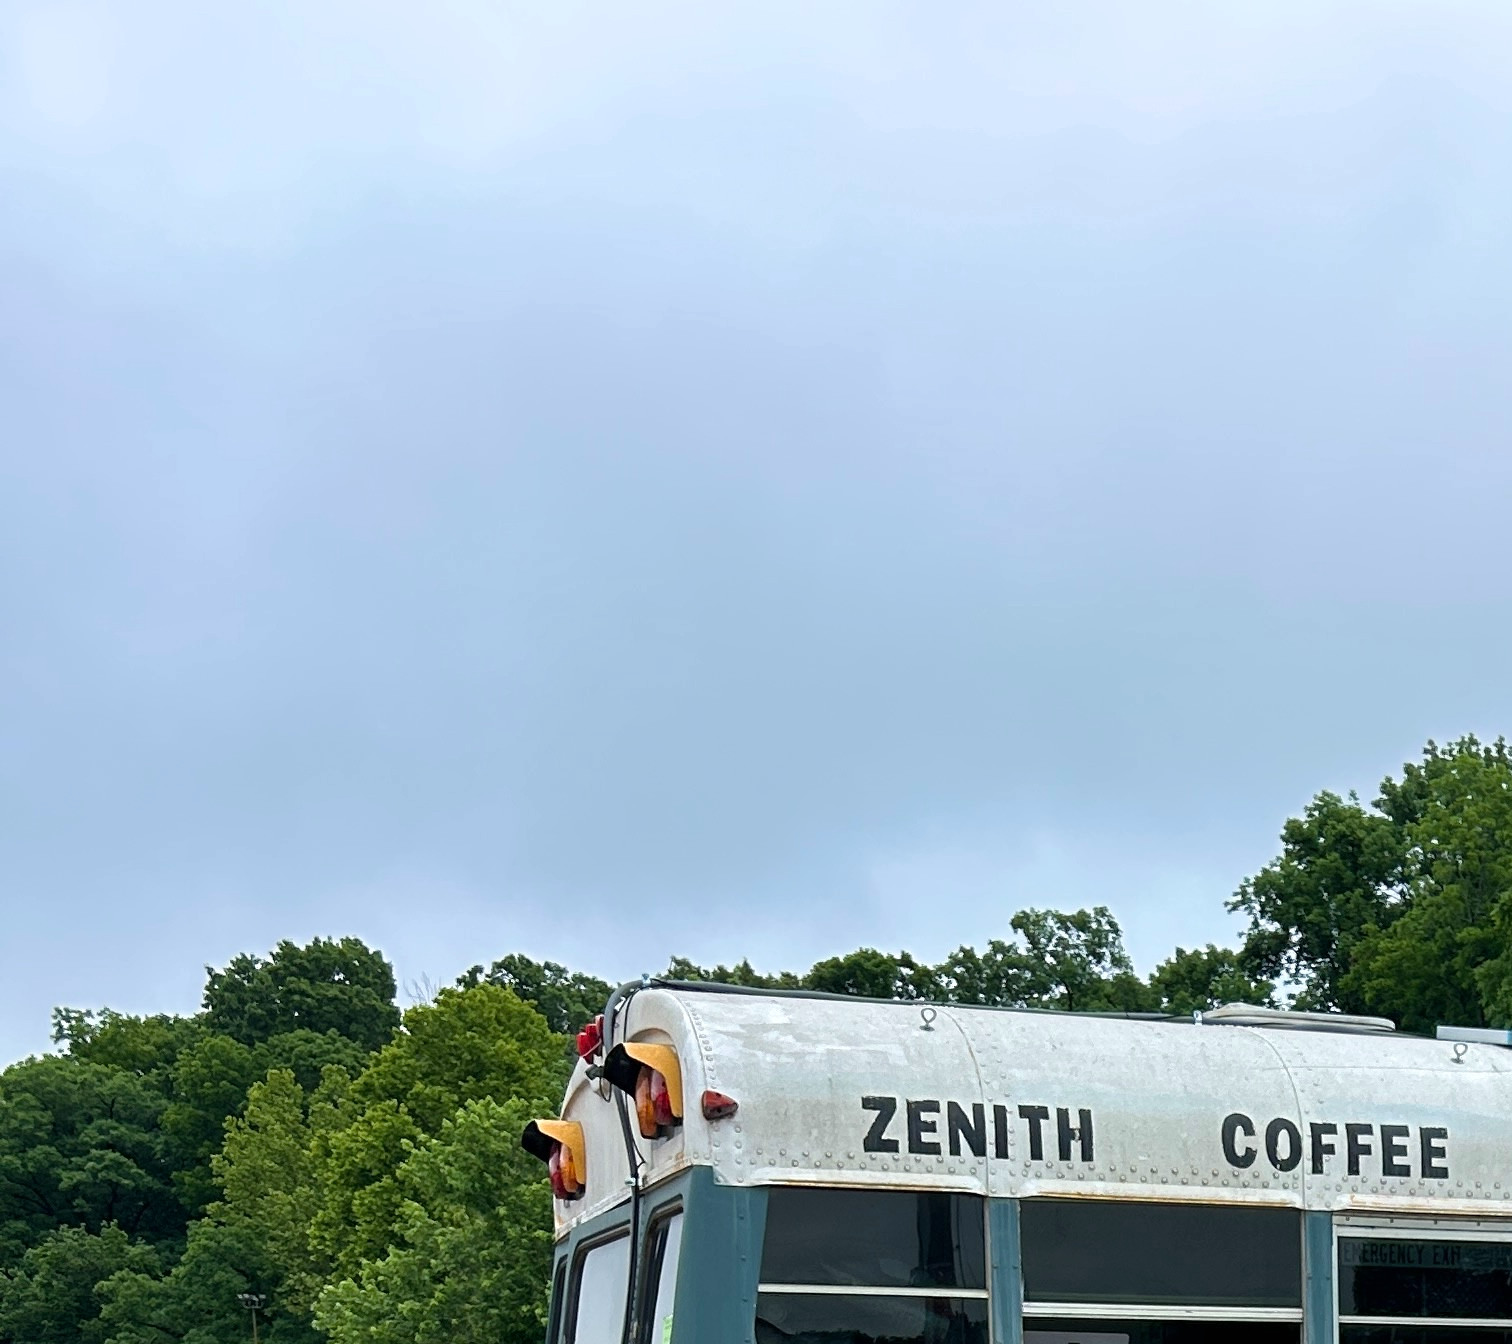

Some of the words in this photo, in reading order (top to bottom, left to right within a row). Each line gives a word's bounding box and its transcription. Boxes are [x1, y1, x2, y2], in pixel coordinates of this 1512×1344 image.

[861, 1096, 1095, 1163] ZENITH
[1220, 1113, 1449, 1180] COFFEE
[1343, 1242, 1424, 1265] EMERGENCY
[1433, 1244, 1462, 1265] EXIT
